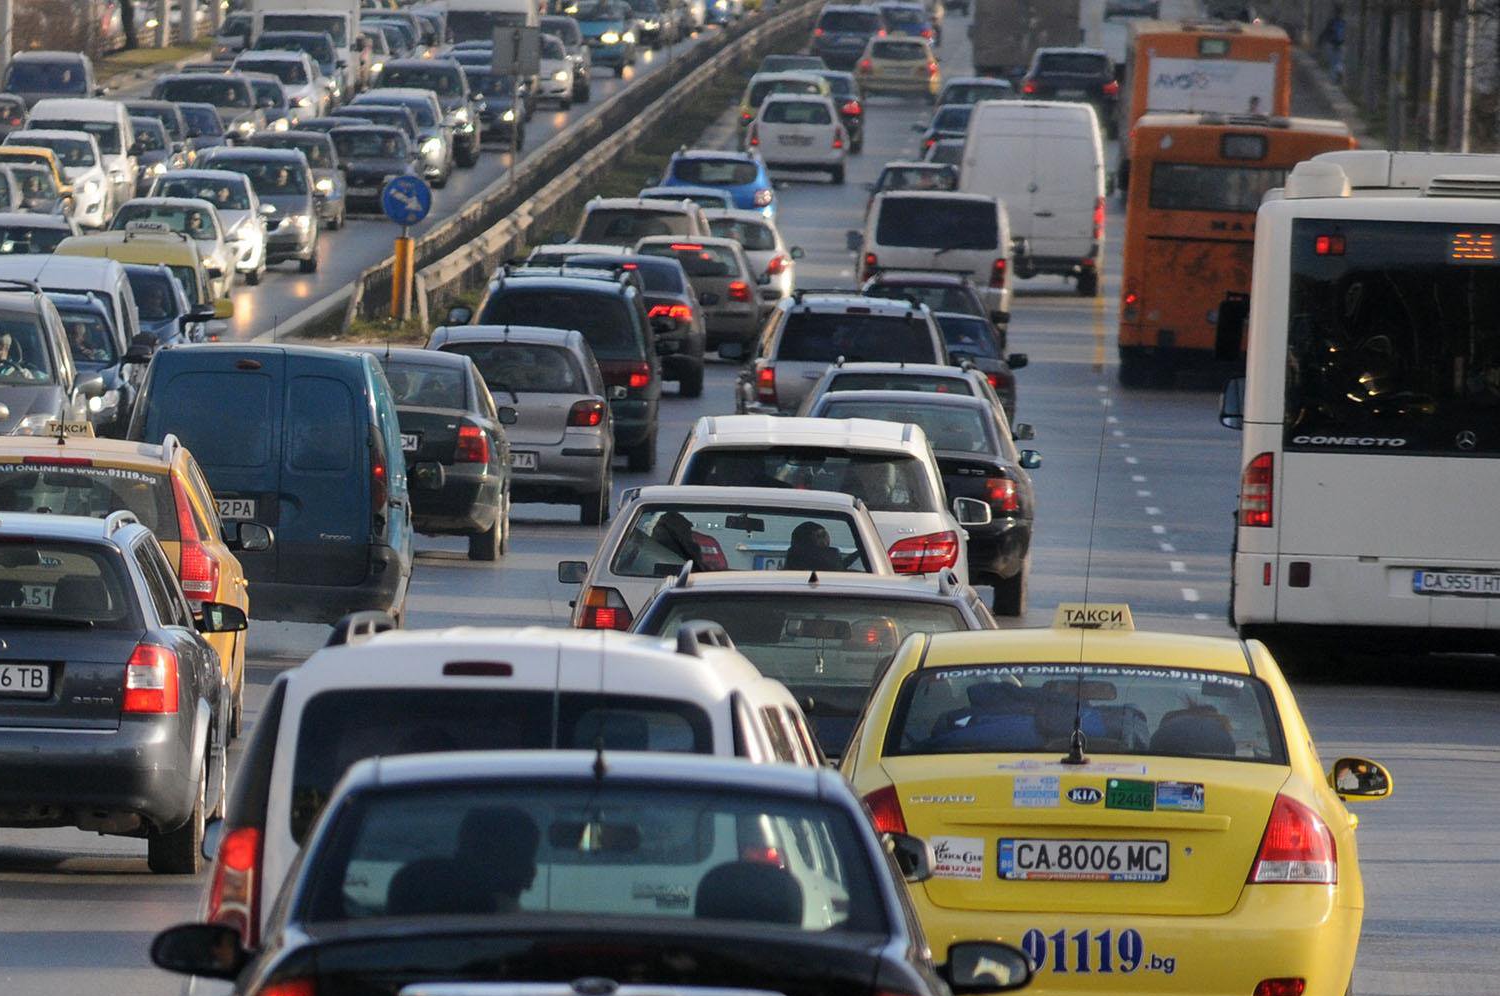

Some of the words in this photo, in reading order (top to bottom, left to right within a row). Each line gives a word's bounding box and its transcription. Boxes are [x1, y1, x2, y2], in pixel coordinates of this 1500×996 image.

[49, 422, 88, 434] ТАКСИ
[1293, 435, 1407, 447] CONECTO
[16, 465, 59, 474] ONLINE
[76, 466, 157, 485] www.91119.bg
[233, 501, 251, 516] PA
[1424, 575, 1442, 588] CA
[1447, 576, 1480, 590] 9551
[1063, 609, 1123, 623] ТАКСИ
[18, 668, 44, 688] TB
[936, 665, 1023, 680] ПОРЪЧАЙ
[1027, 665, 1093, 675] ONLINE
[1121, 667, 1245, 688] www.91119.bg
[1073, 788, 1098, 800] KIA
[1017, 844, 1052, 870] CA
[1058, 845, 1121, 870] 8006
[1127, 846, 1162, 872] MC
